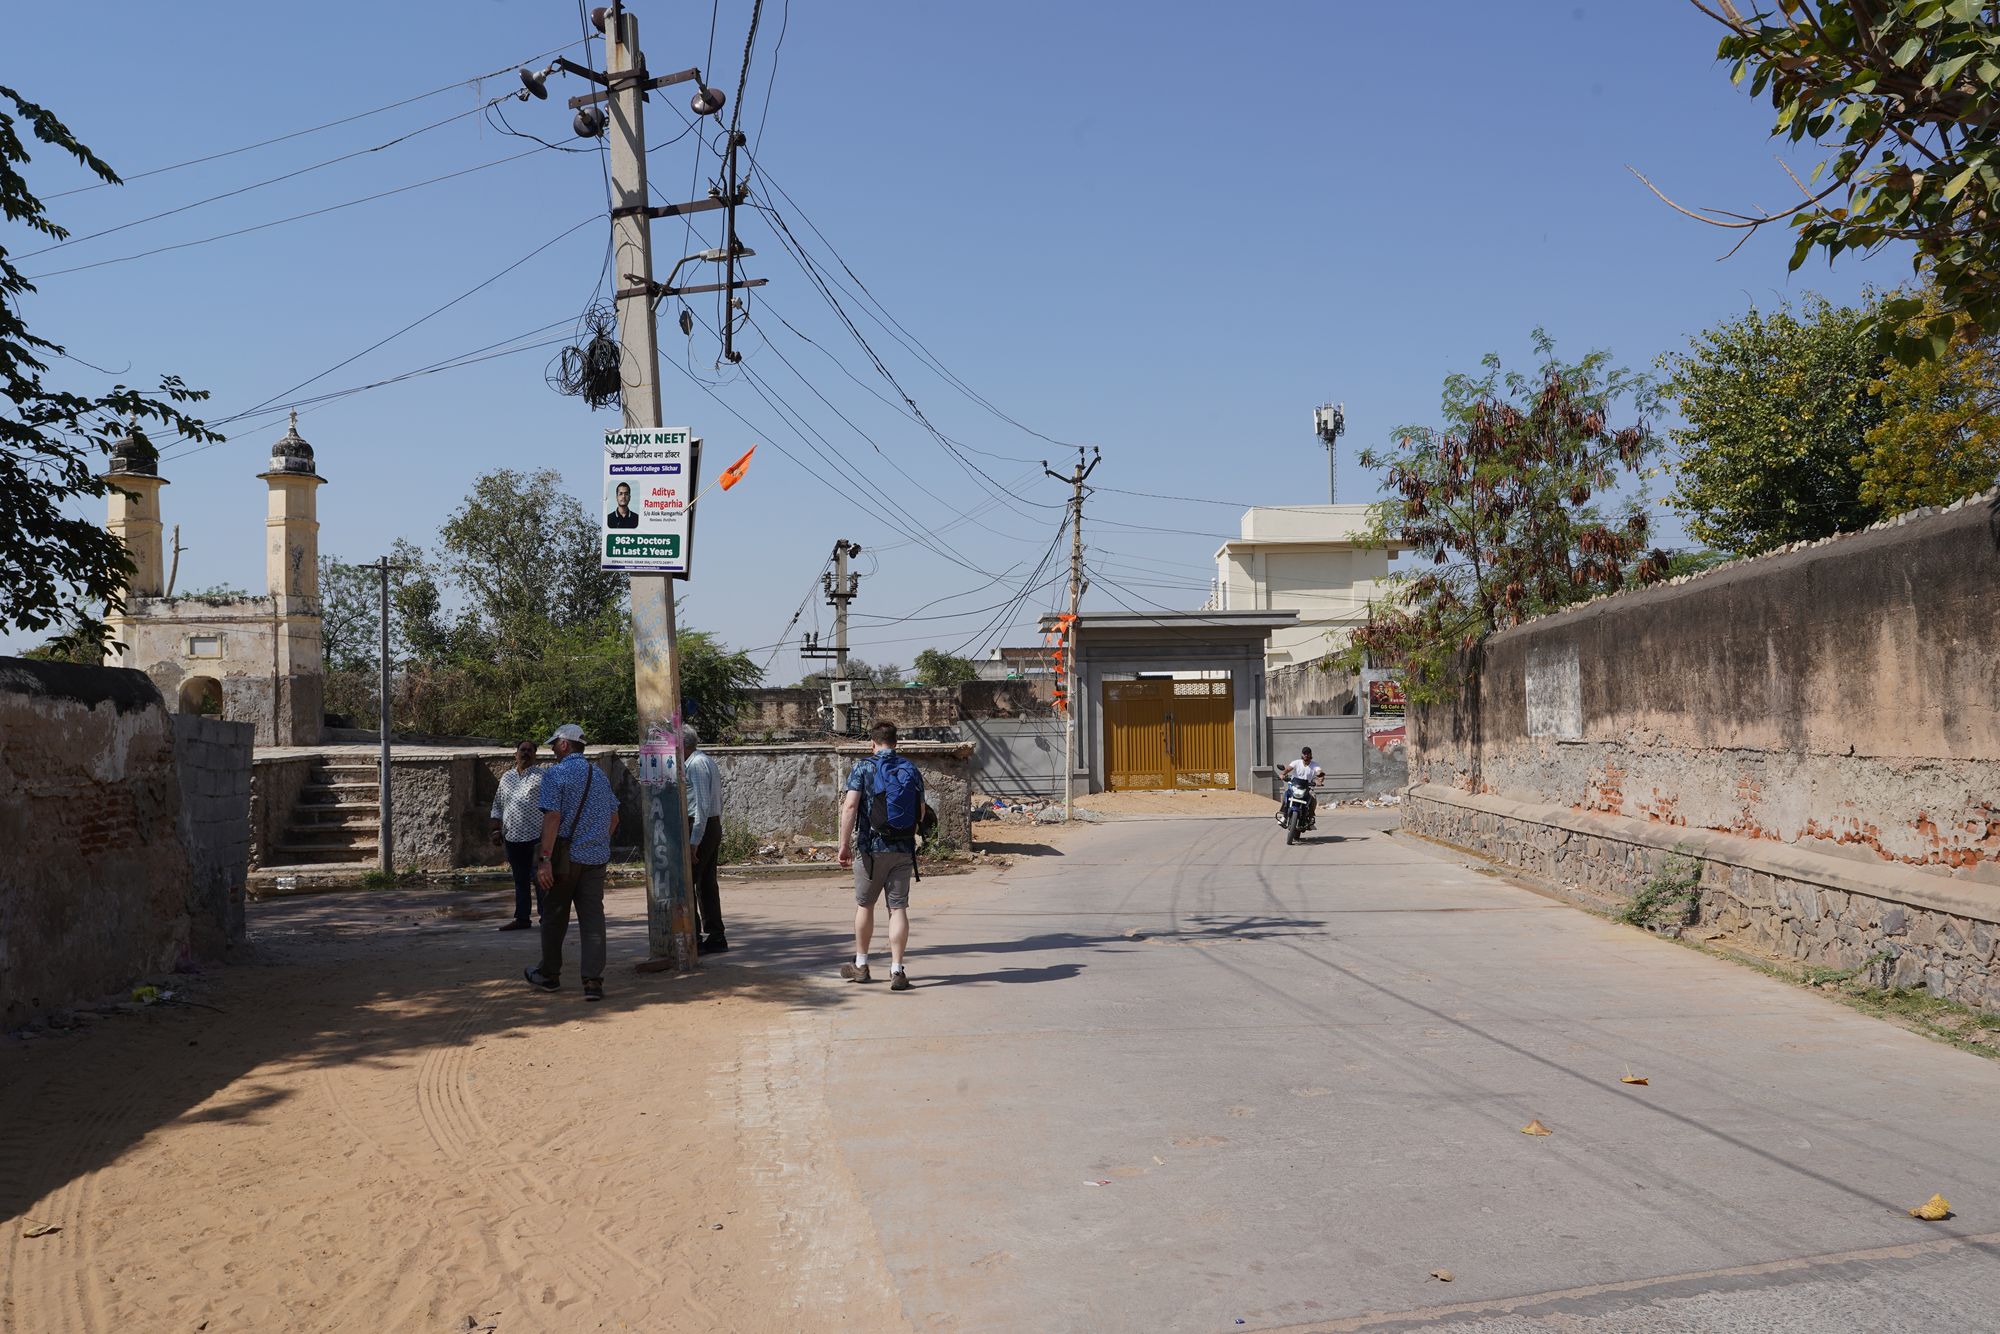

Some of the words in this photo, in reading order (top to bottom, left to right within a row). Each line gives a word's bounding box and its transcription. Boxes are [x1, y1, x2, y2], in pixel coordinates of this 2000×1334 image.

[605, 434, 651, 445] MATRIX
[655, 433, 686, 444] NEET
[643, 465, 660, 473] College
[652, 488, 675, 498] Aditya
[644, 500, 683, 510] Ramgarhia
[615, 536, 635, 545] 962+
[637, 536, 671, 545] Doctors
[612, 546, 621, 555] in
[622, 547, 640, 556] Last
[642, 547, 648, 556] 2
[649, 547, 673, 556] Years
